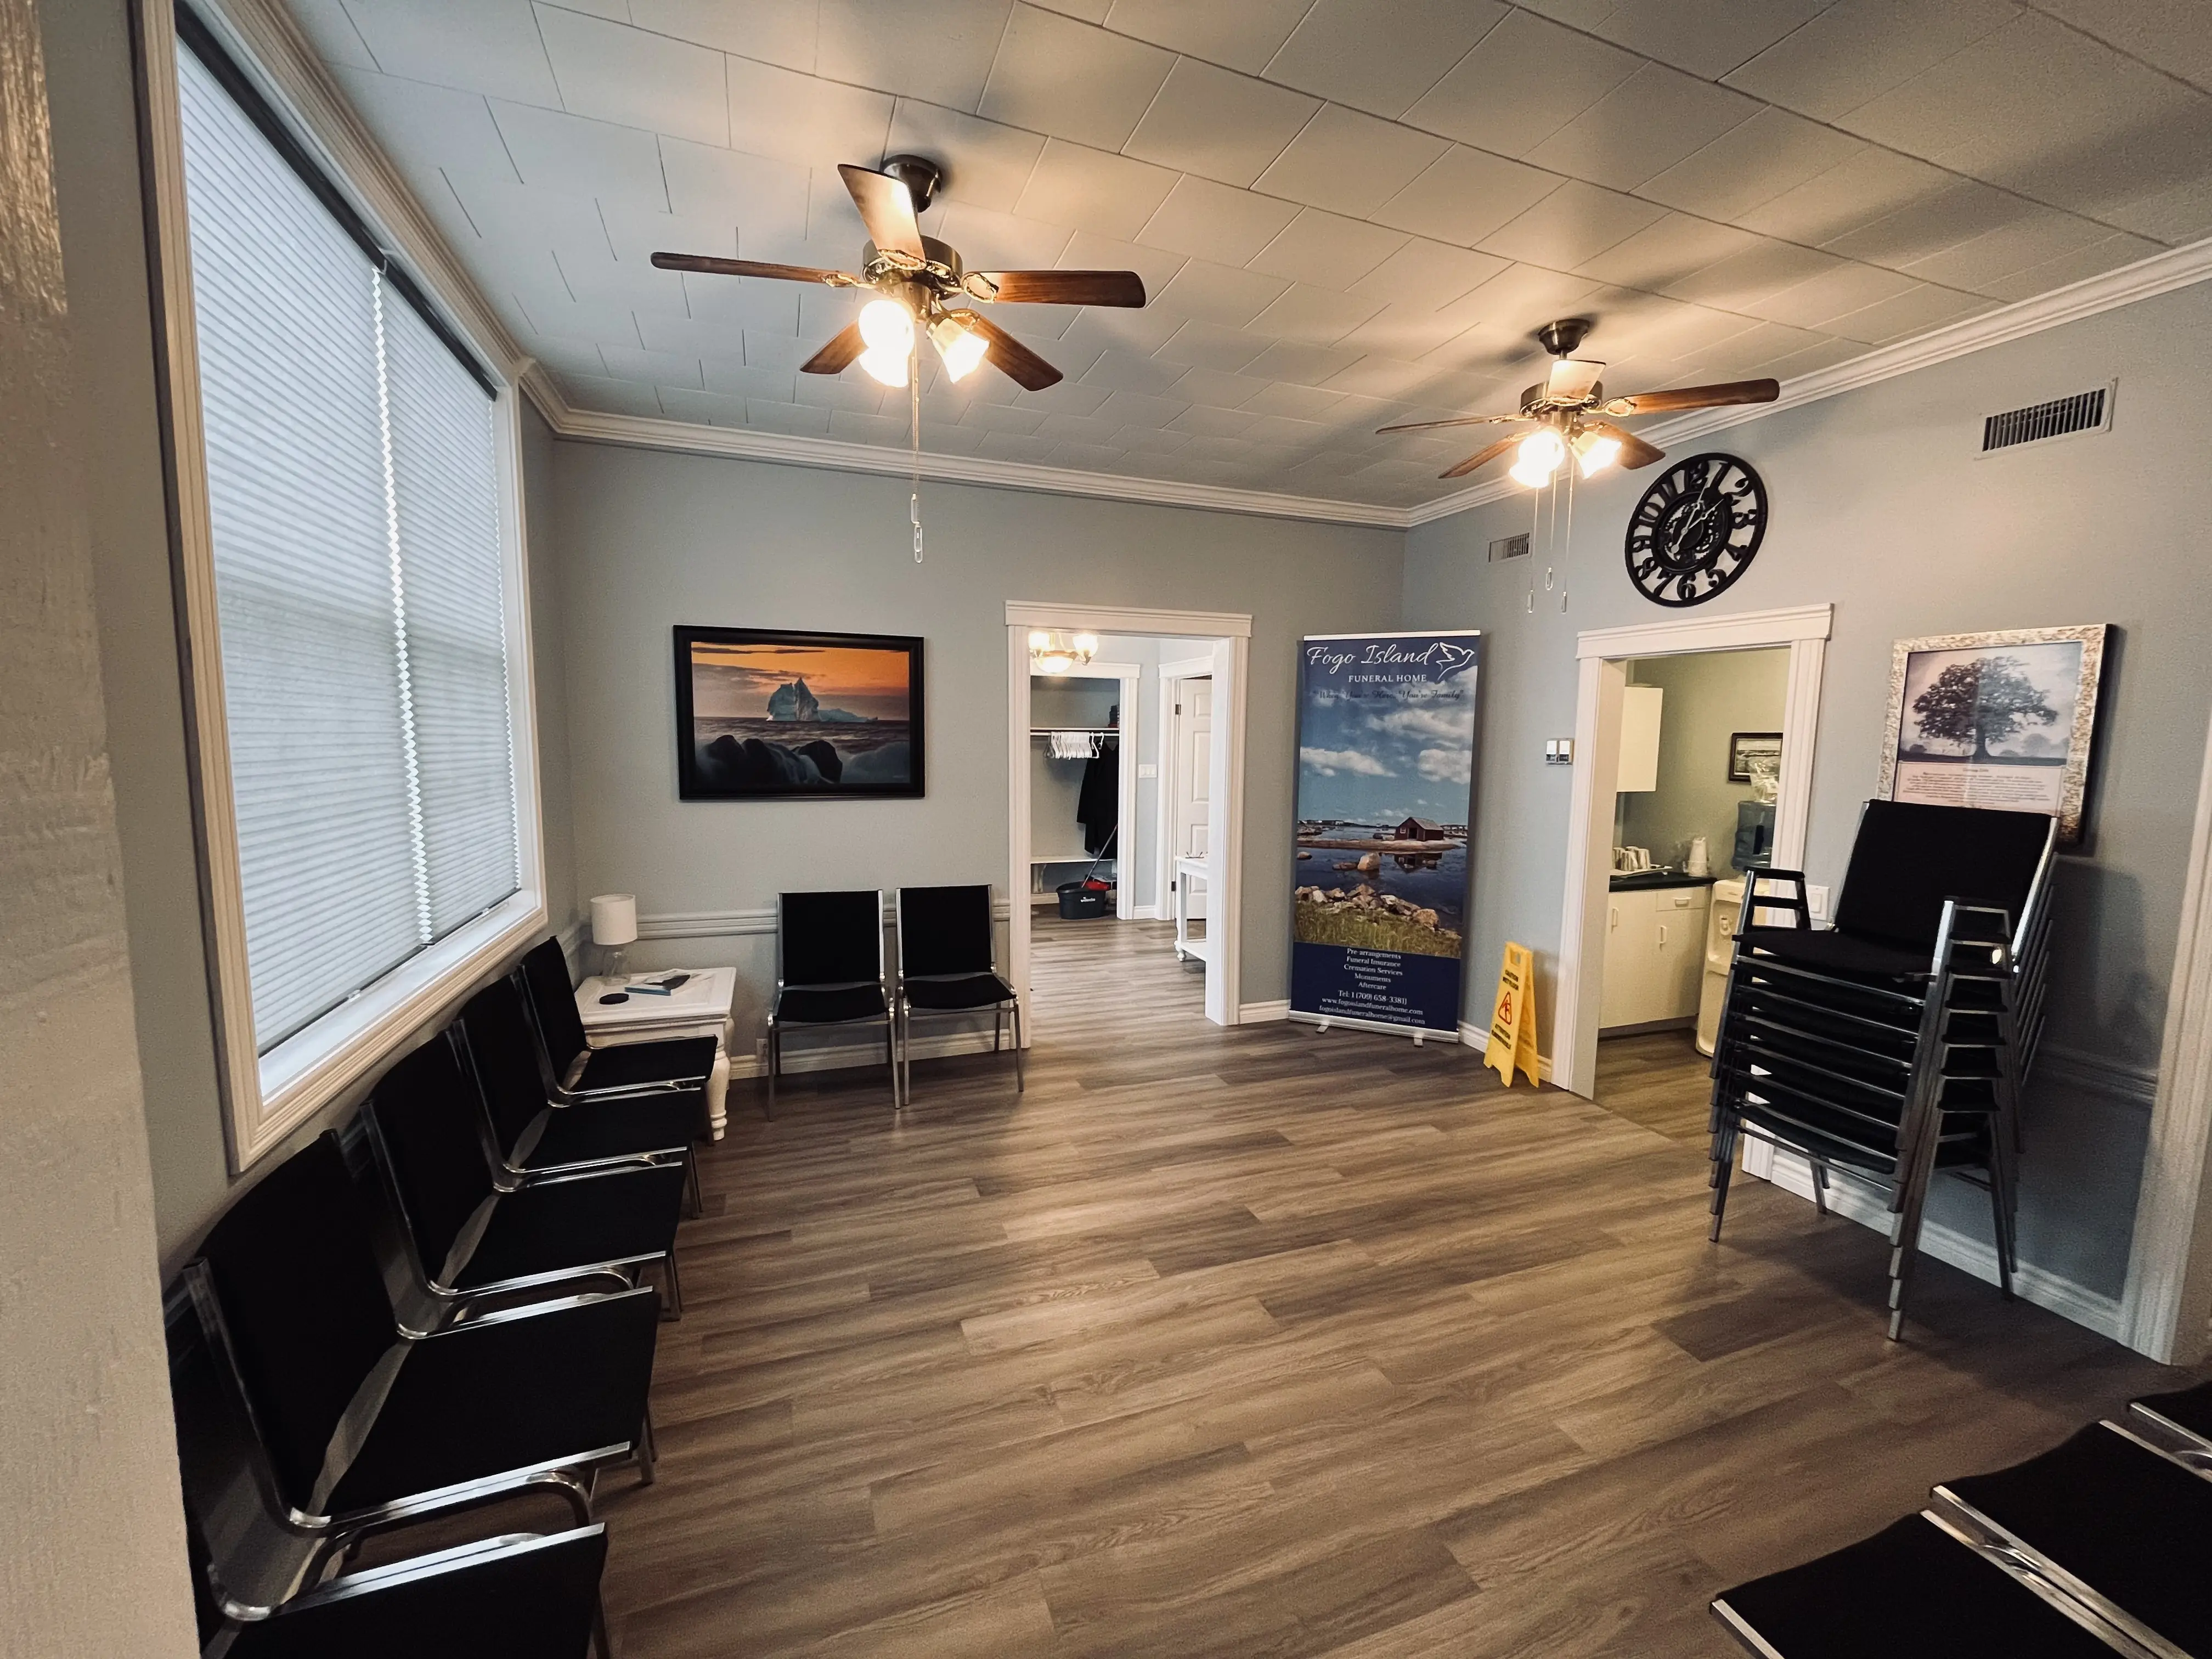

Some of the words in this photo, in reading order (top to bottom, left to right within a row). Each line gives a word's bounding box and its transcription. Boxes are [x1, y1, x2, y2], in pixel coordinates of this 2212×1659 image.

[1306, 646, 1356, 674] Fogo
[1361, 643, 1439, 665] Island
[1396, 674, 1426, 682] HOME
[1346, 956, 1369, 964] Funeral
[1370, 958, 1401, 967] Insurance
[1344, 964, 1376, 973] Cremation
[1377, 967, 1403, 975] Services
[1355, 972, 1391, 983] Monuments
[1358, 981, 1386, 990] Aftercare
[1356, 992, 1373, 1001] (709)
[1322, 998, 1423, 1015] www.fogoislandfuneralhome.com
[1319, 1005, 1425, 1025] fogoislandfuneralhome@gmail.com
